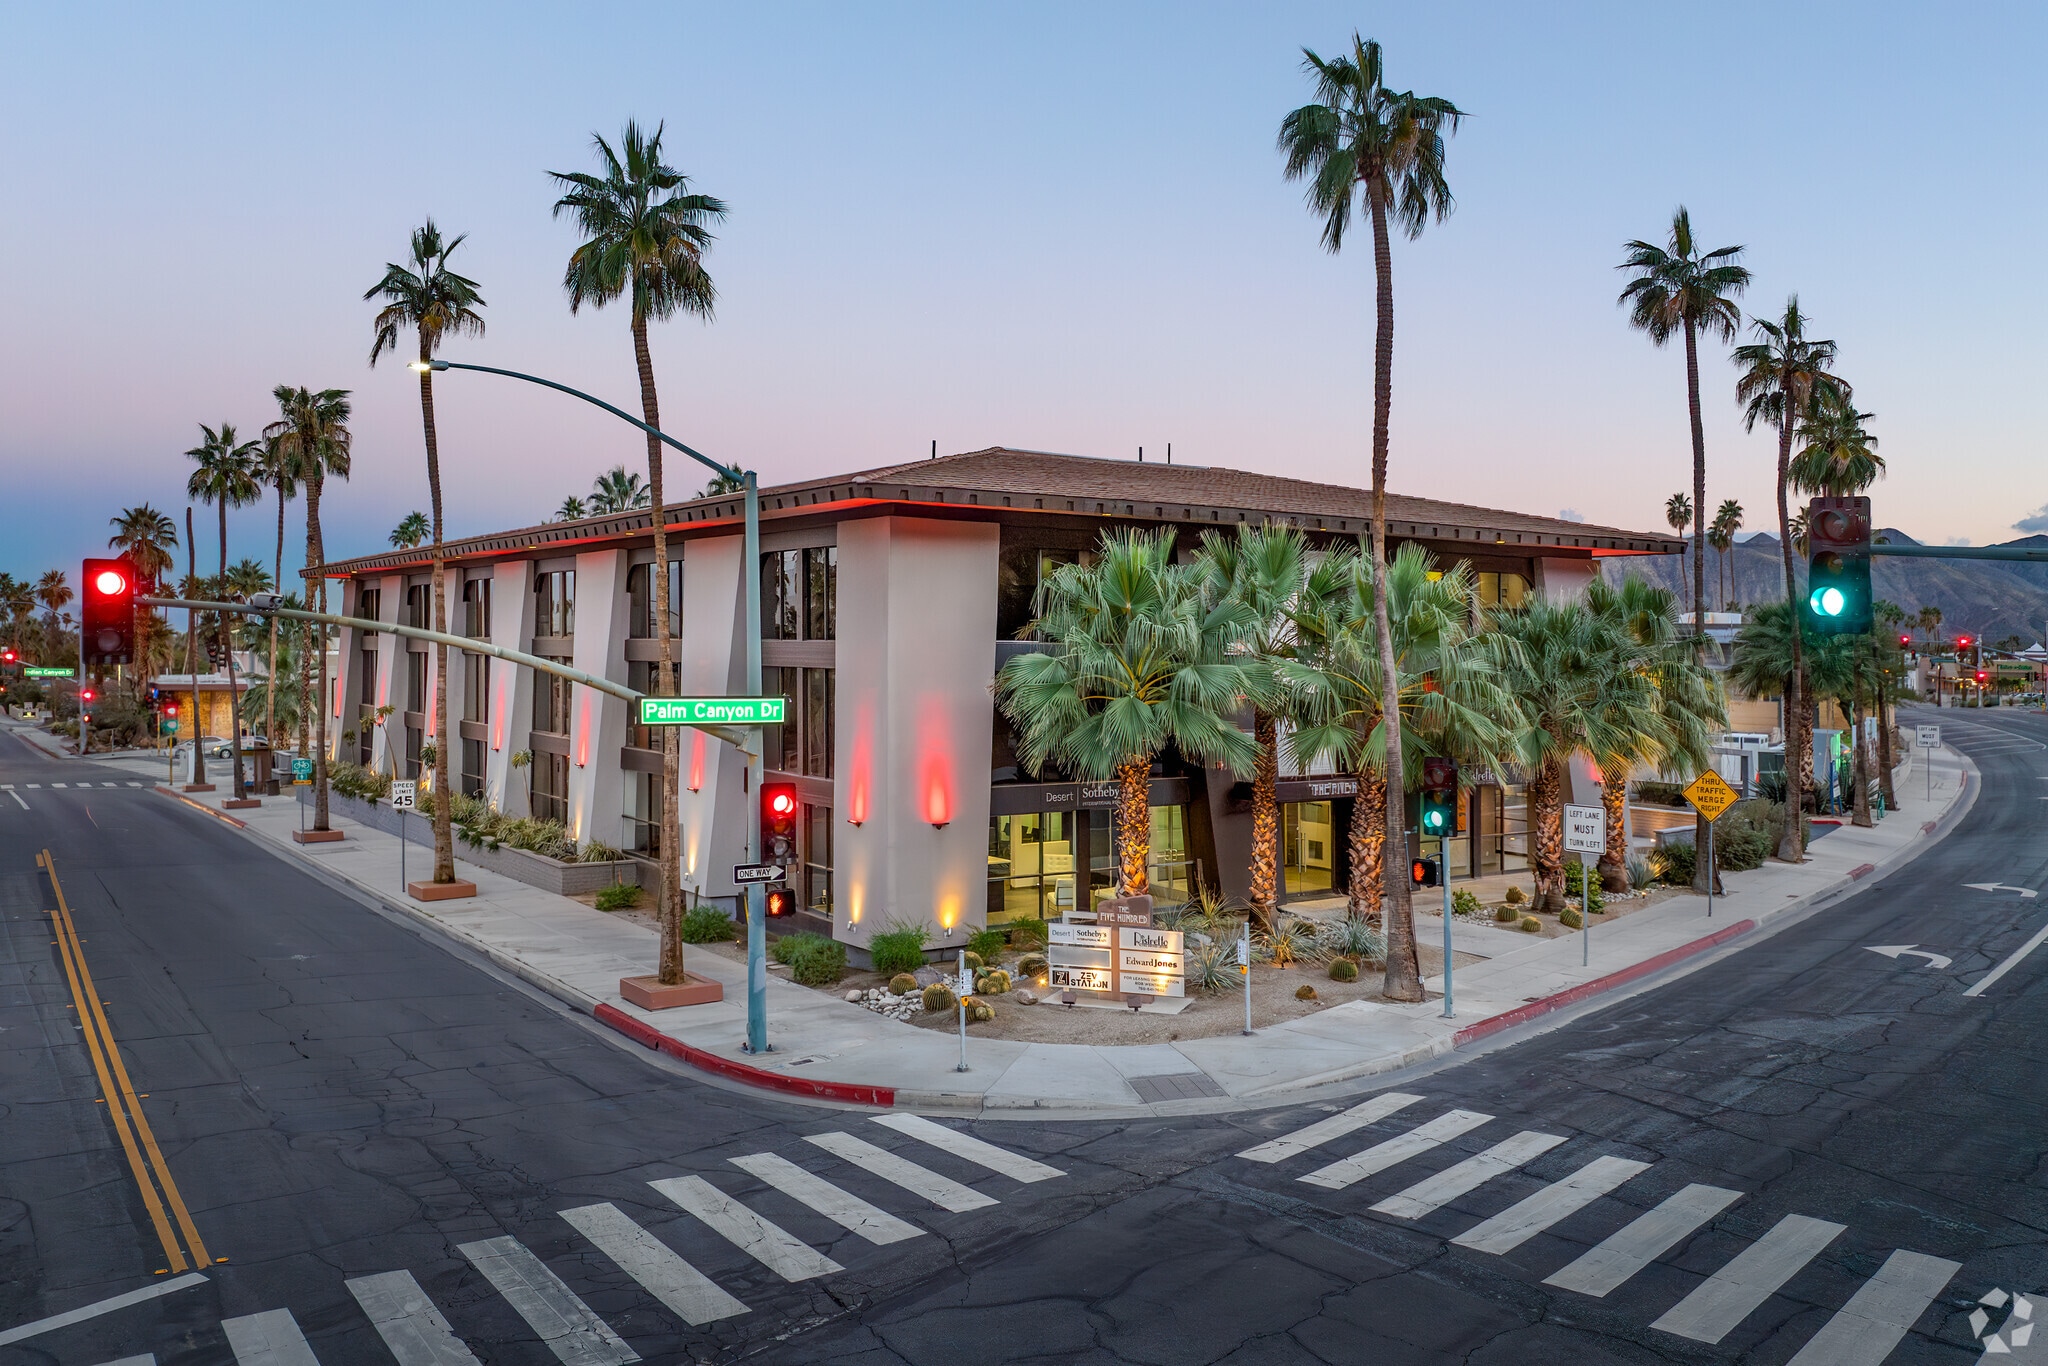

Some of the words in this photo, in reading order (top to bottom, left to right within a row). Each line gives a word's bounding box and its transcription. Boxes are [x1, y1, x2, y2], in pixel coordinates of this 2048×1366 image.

[645, 703, 687, 719] Palm
[694, 703, 754, 721] Canyon
[761, 702, 780, 718] Dr
[1701, 777, 1721, 786] THRU
[1046, 791, 1074, 802] Desert
[1082, 786, 1120, 799] Sotheby
[1696, 786, 1727, 796] TRAFFIC
[393, 795, 413, 806] 45
[1697, 795, 1726, 804] MERGE
[1700, 804, 1721, 813] RIGHT
[1569, 810, 1583, 818] LEFT
[1584, 811, 1600, 820] LANE
[1573, 824, 1595, 835] MUST
[1569, 838, 1584, 847] TURN
[1586, 840, 1601, 849] LEFT
[740, 869, 754, 878] ONE
[755, 868, 771, 877] WAY
[1118, 905, 1130, 913] THE
[1100, 912, 1116, 922] FIVE
[1117, 913, 1148, 924] HUNDRED
[1051, 929, 1071, 937] Desert
[1076, 929, 1107, 939] Sotheby's
[1080, 971, 1098, 980] ZEV
